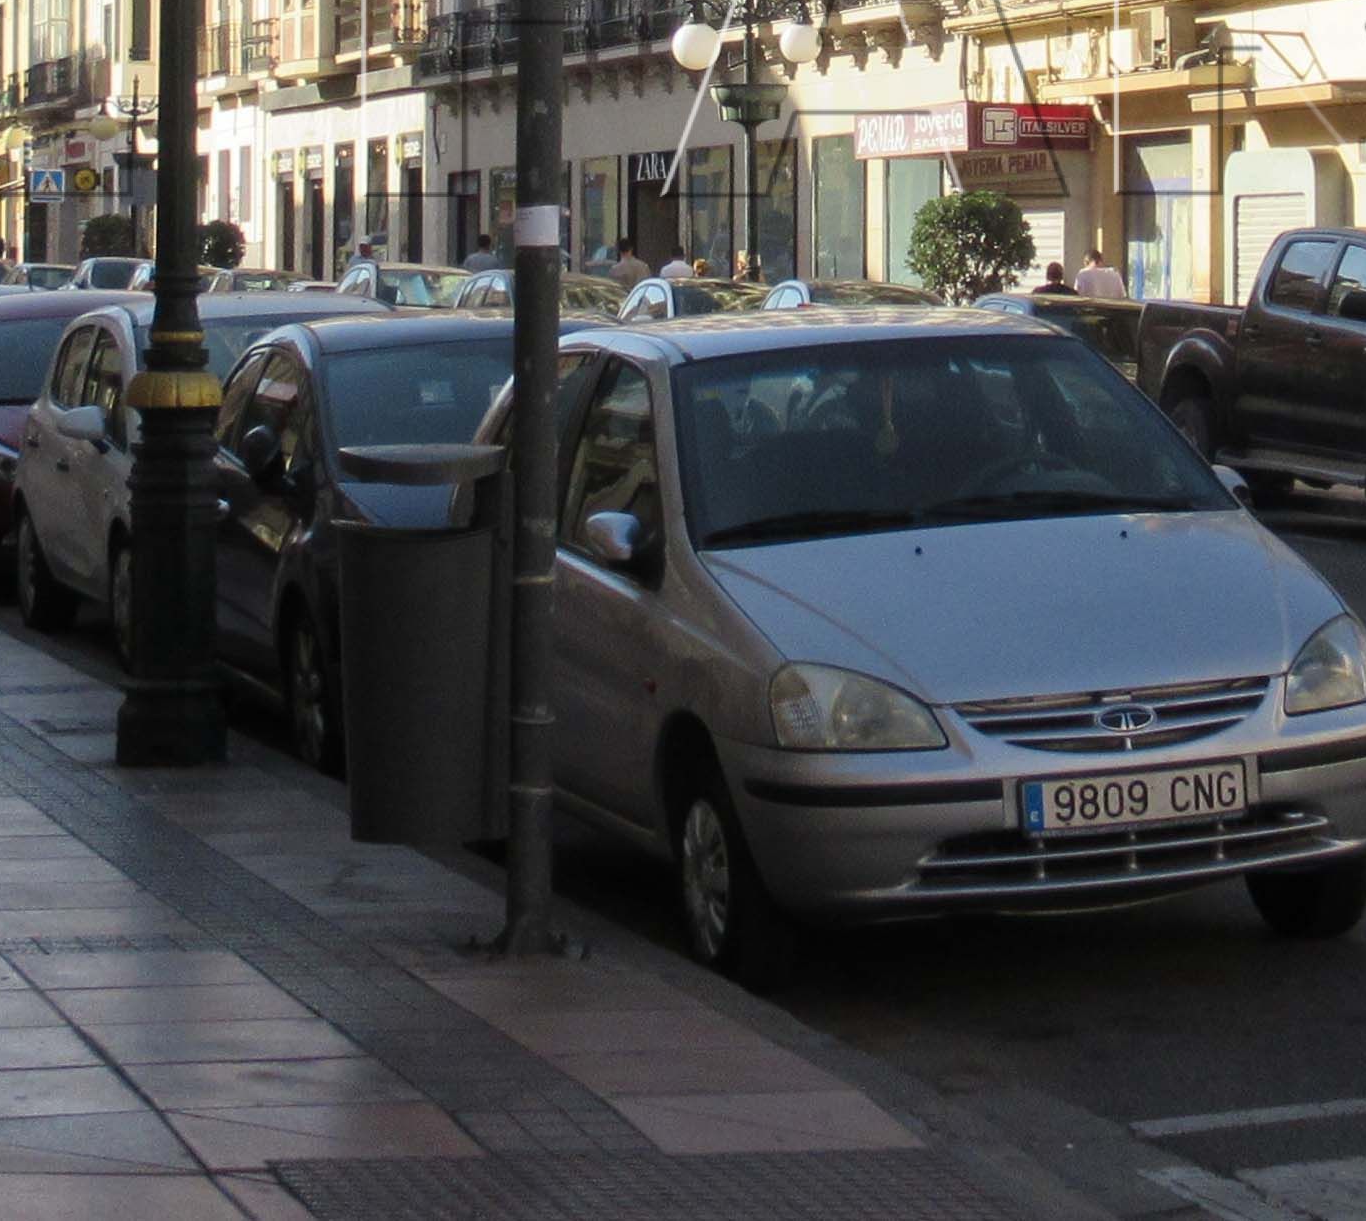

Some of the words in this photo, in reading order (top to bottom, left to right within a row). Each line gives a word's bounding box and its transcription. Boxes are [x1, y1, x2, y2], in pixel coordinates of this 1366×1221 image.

[1022, 120, 1087, 135] ITALSILVER
[636, 153, 668, 182] ZARA
[1053, 779, 1148, 822] 9809
[1170, 771, 1237, 813] CNG
